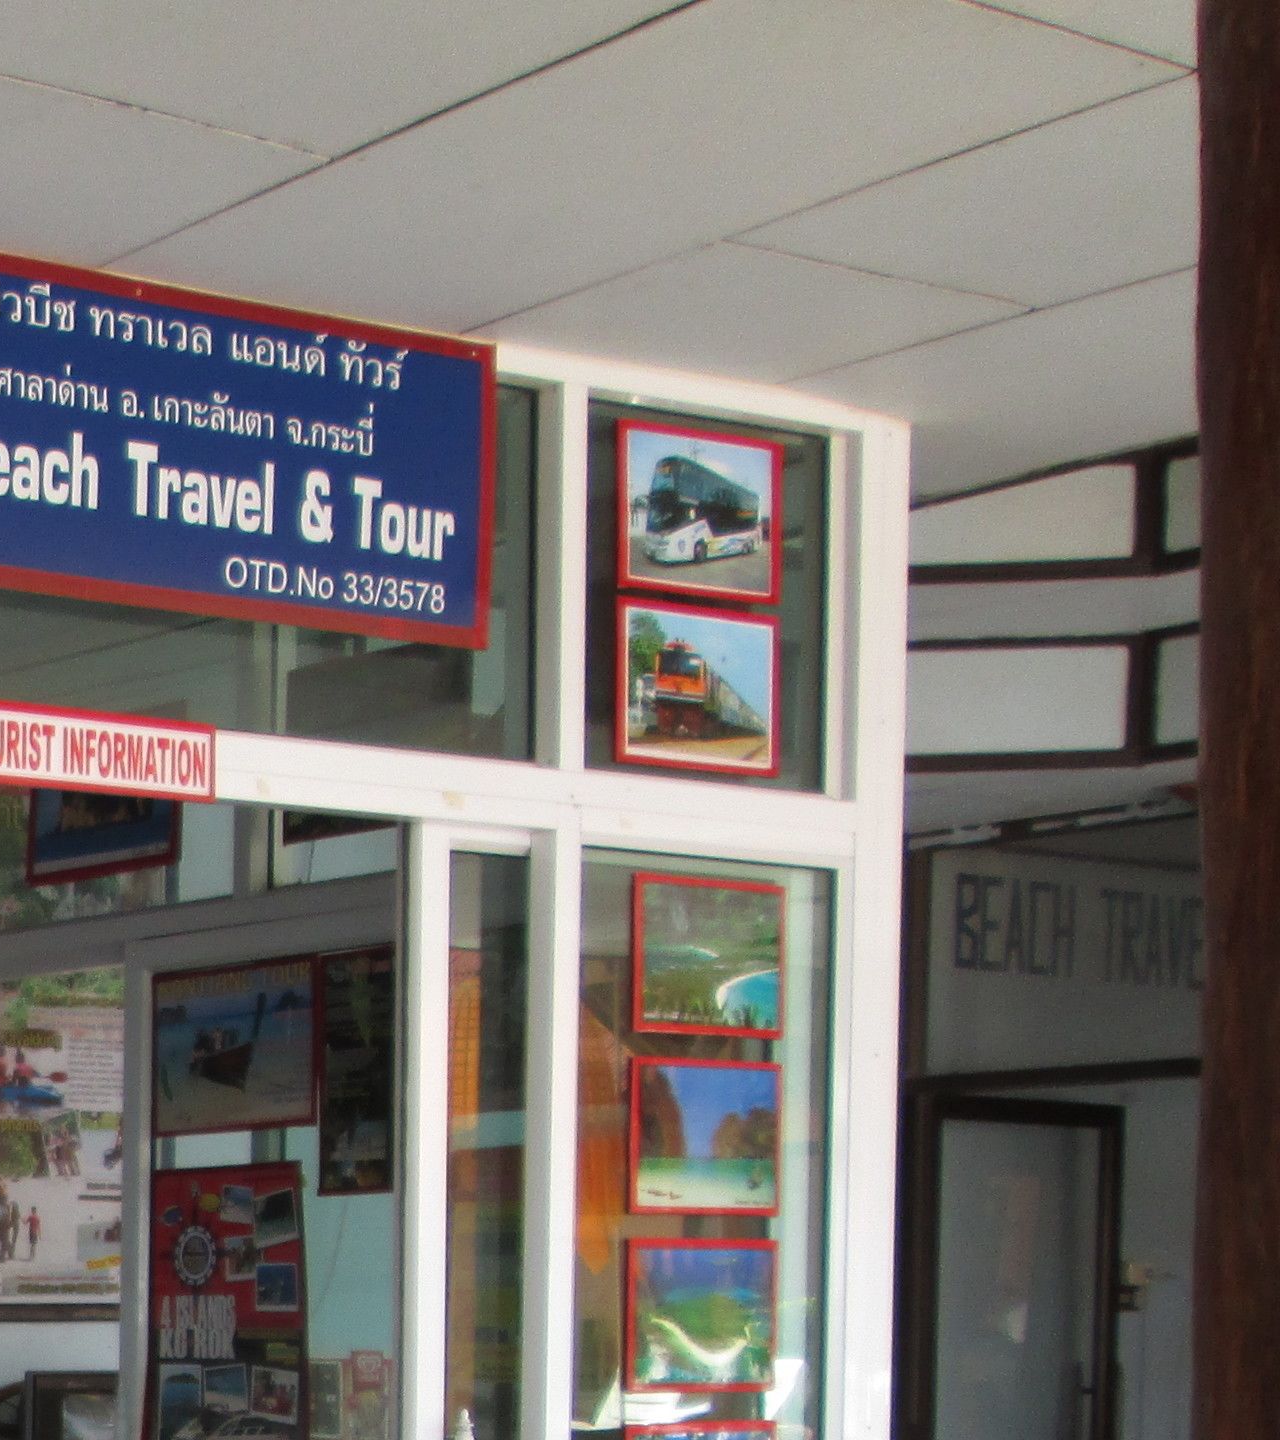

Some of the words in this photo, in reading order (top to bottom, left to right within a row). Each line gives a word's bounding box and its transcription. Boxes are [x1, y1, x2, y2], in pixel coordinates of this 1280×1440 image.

[89, 304, 212, 356] ทราเวล
[231, 333, 329, 377] แอนด์
[340, 338, 409, 391] ทัวร์
[287, 402, 375, 457] จ.กระบี่
[127, 439, 276, 535] Travel
[301, 468, 333, 543] &
[354, 476, 456, 562] Tour
[225, 555, 334, 600] OTD.No
[343, 571, 446, 615] 33/3578
[63, 725, 207, 788] INFORMATION
[953, 871, 1078, 978] BEACH
[159, 1294, 172, 1329] 4
[176, 1294, 236, 1330] ISLANDS
[159, 1327, 189, 1359] KO
[192, 1327, 236, 1360] ROK
